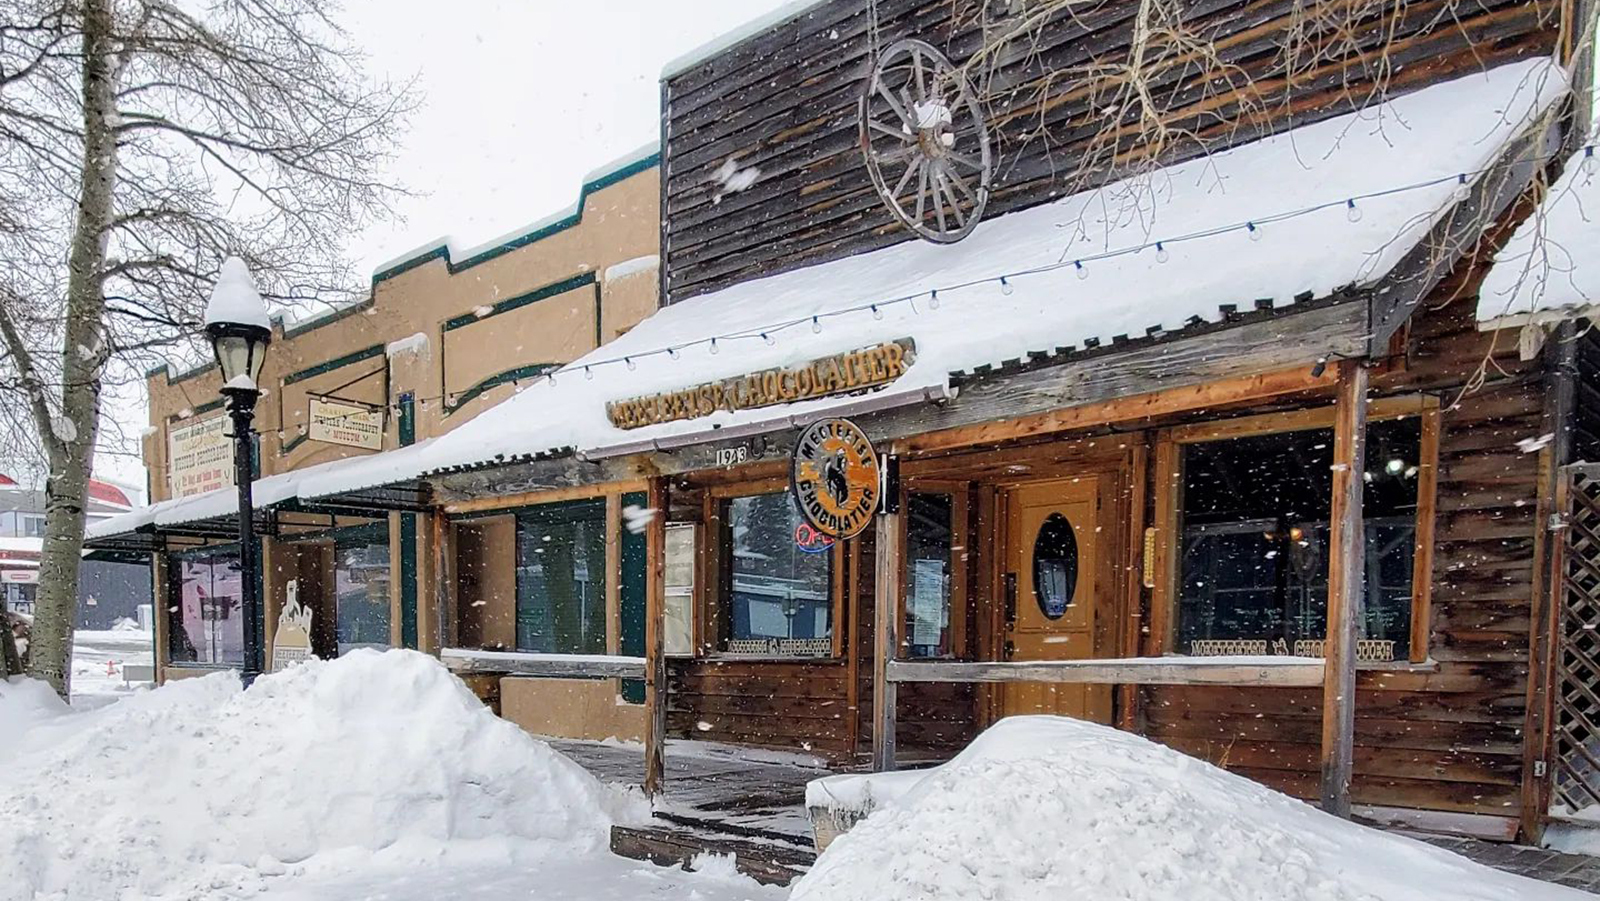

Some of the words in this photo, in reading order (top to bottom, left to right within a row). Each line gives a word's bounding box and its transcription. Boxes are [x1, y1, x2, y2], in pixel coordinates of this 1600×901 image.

[731, 343, 904, 412] CHOCOLATIER
[718, 447, 746, 465] 1943
[801, 423, 872, 468] MEETEETSE
[800, 479, 874, 532] CHOCOLATIER
[1191, 639, 1267, 656] MEETEETSE
[1294, 639, 1395, 661] CHOTIER
